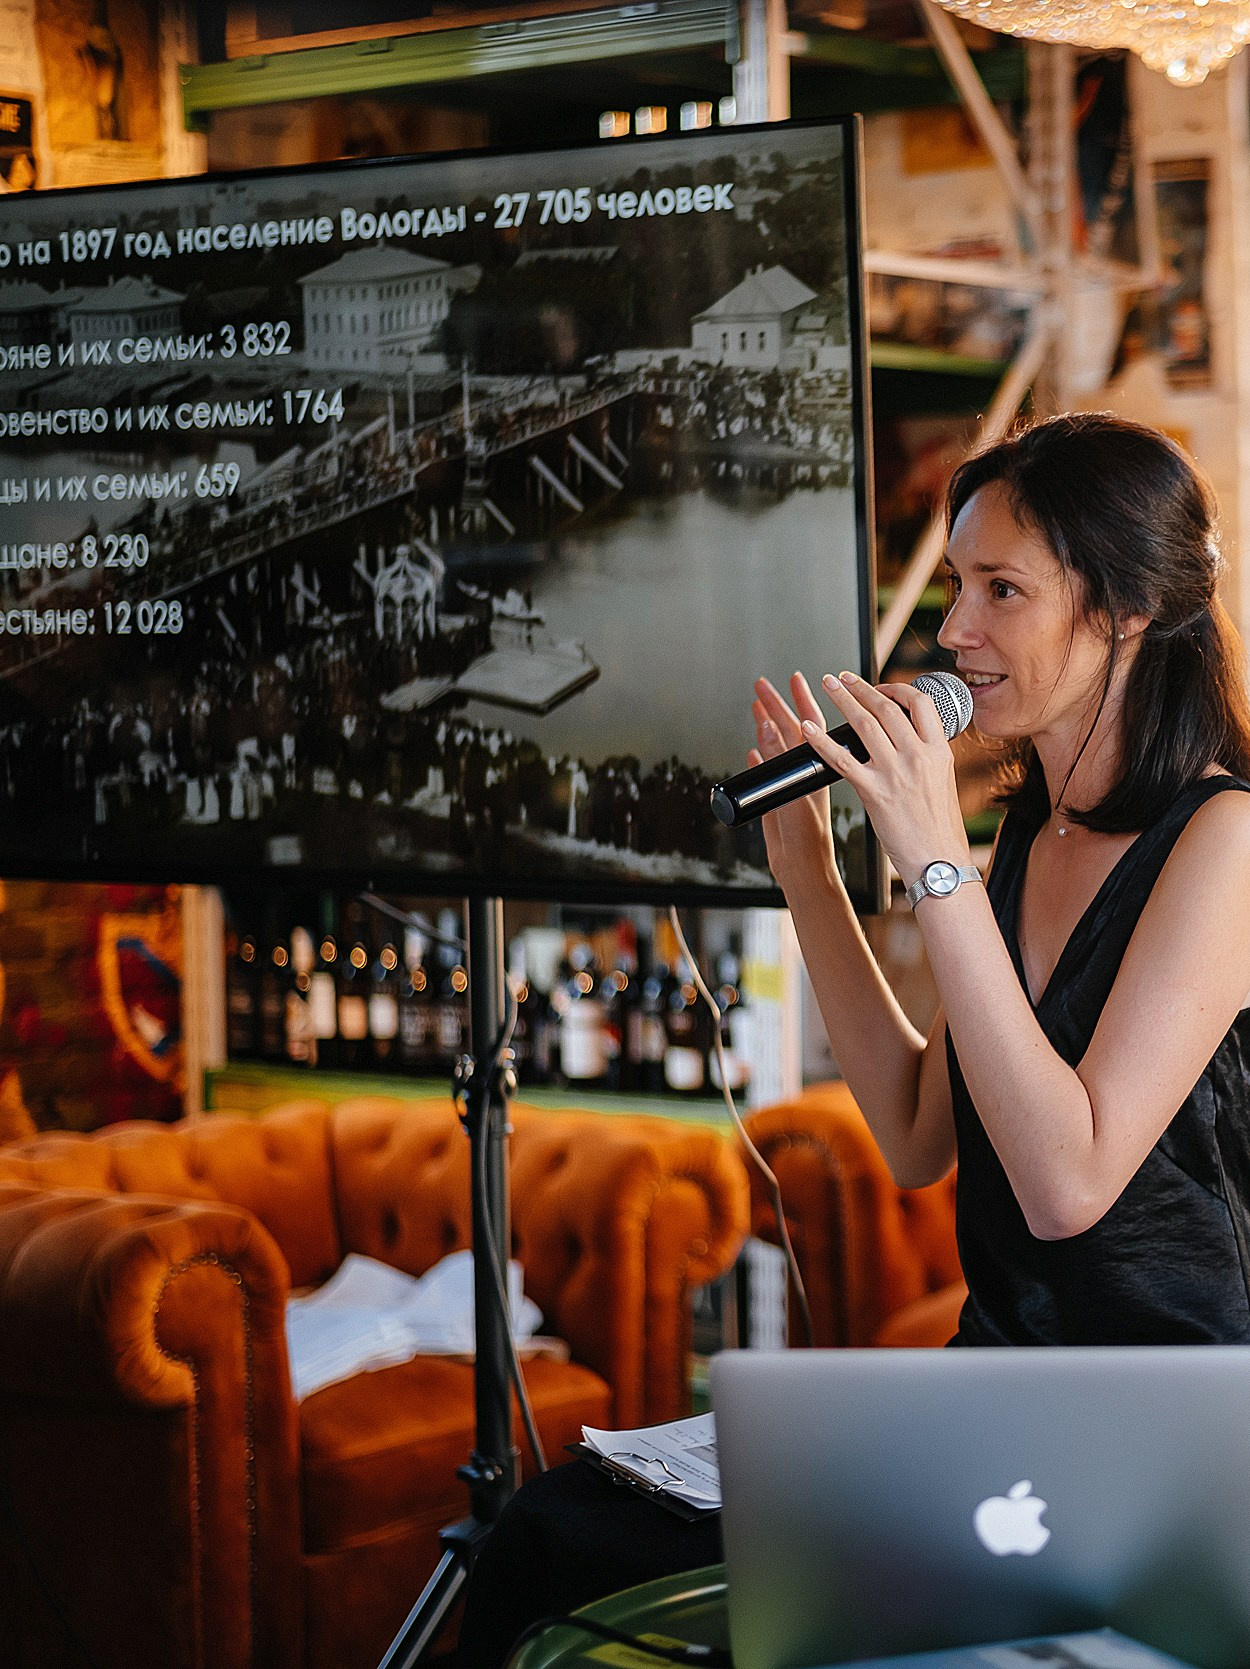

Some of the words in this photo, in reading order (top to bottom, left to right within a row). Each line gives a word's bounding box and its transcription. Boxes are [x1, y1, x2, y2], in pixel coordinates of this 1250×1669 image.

[0, 243, 11, 268] о
[18, 240, 51, 267] на
[60, 228, 117, 262] 1897
[123, 231, 171, 259] год
[177, 215, 333, 252] население
[341, 205, 466, 241] Вологды
[474, 212, 487, 222] -
[494, 194, 528, 229] 27
[538, 188, 592, 225] 705
[598, 183, 735, 219] человек
[57, 341, 75, 367] и
[81, 338, 111, 367] их
[117, 330, 213, 364] семьи:
[219, 325, 237, 358] 3
[243, 321, 292, 357] 832
[115, 405, 132, 432] и
[138, 402, 170, 431] их
[174, 398, 274, 430] семьи:
[282, 388, 346, 424] 1764
[33, 476, 51, 502] и
[56, 474, 87, 502] их
[92, 469, 189, 501] семьи:
[194, 462, 241, 498] 659
[81, 534, 98, 569] 8
[103, 533, 149, 568] 230
[104, 600, 133, 635] 12
[136, 600, 184, 635] 028
